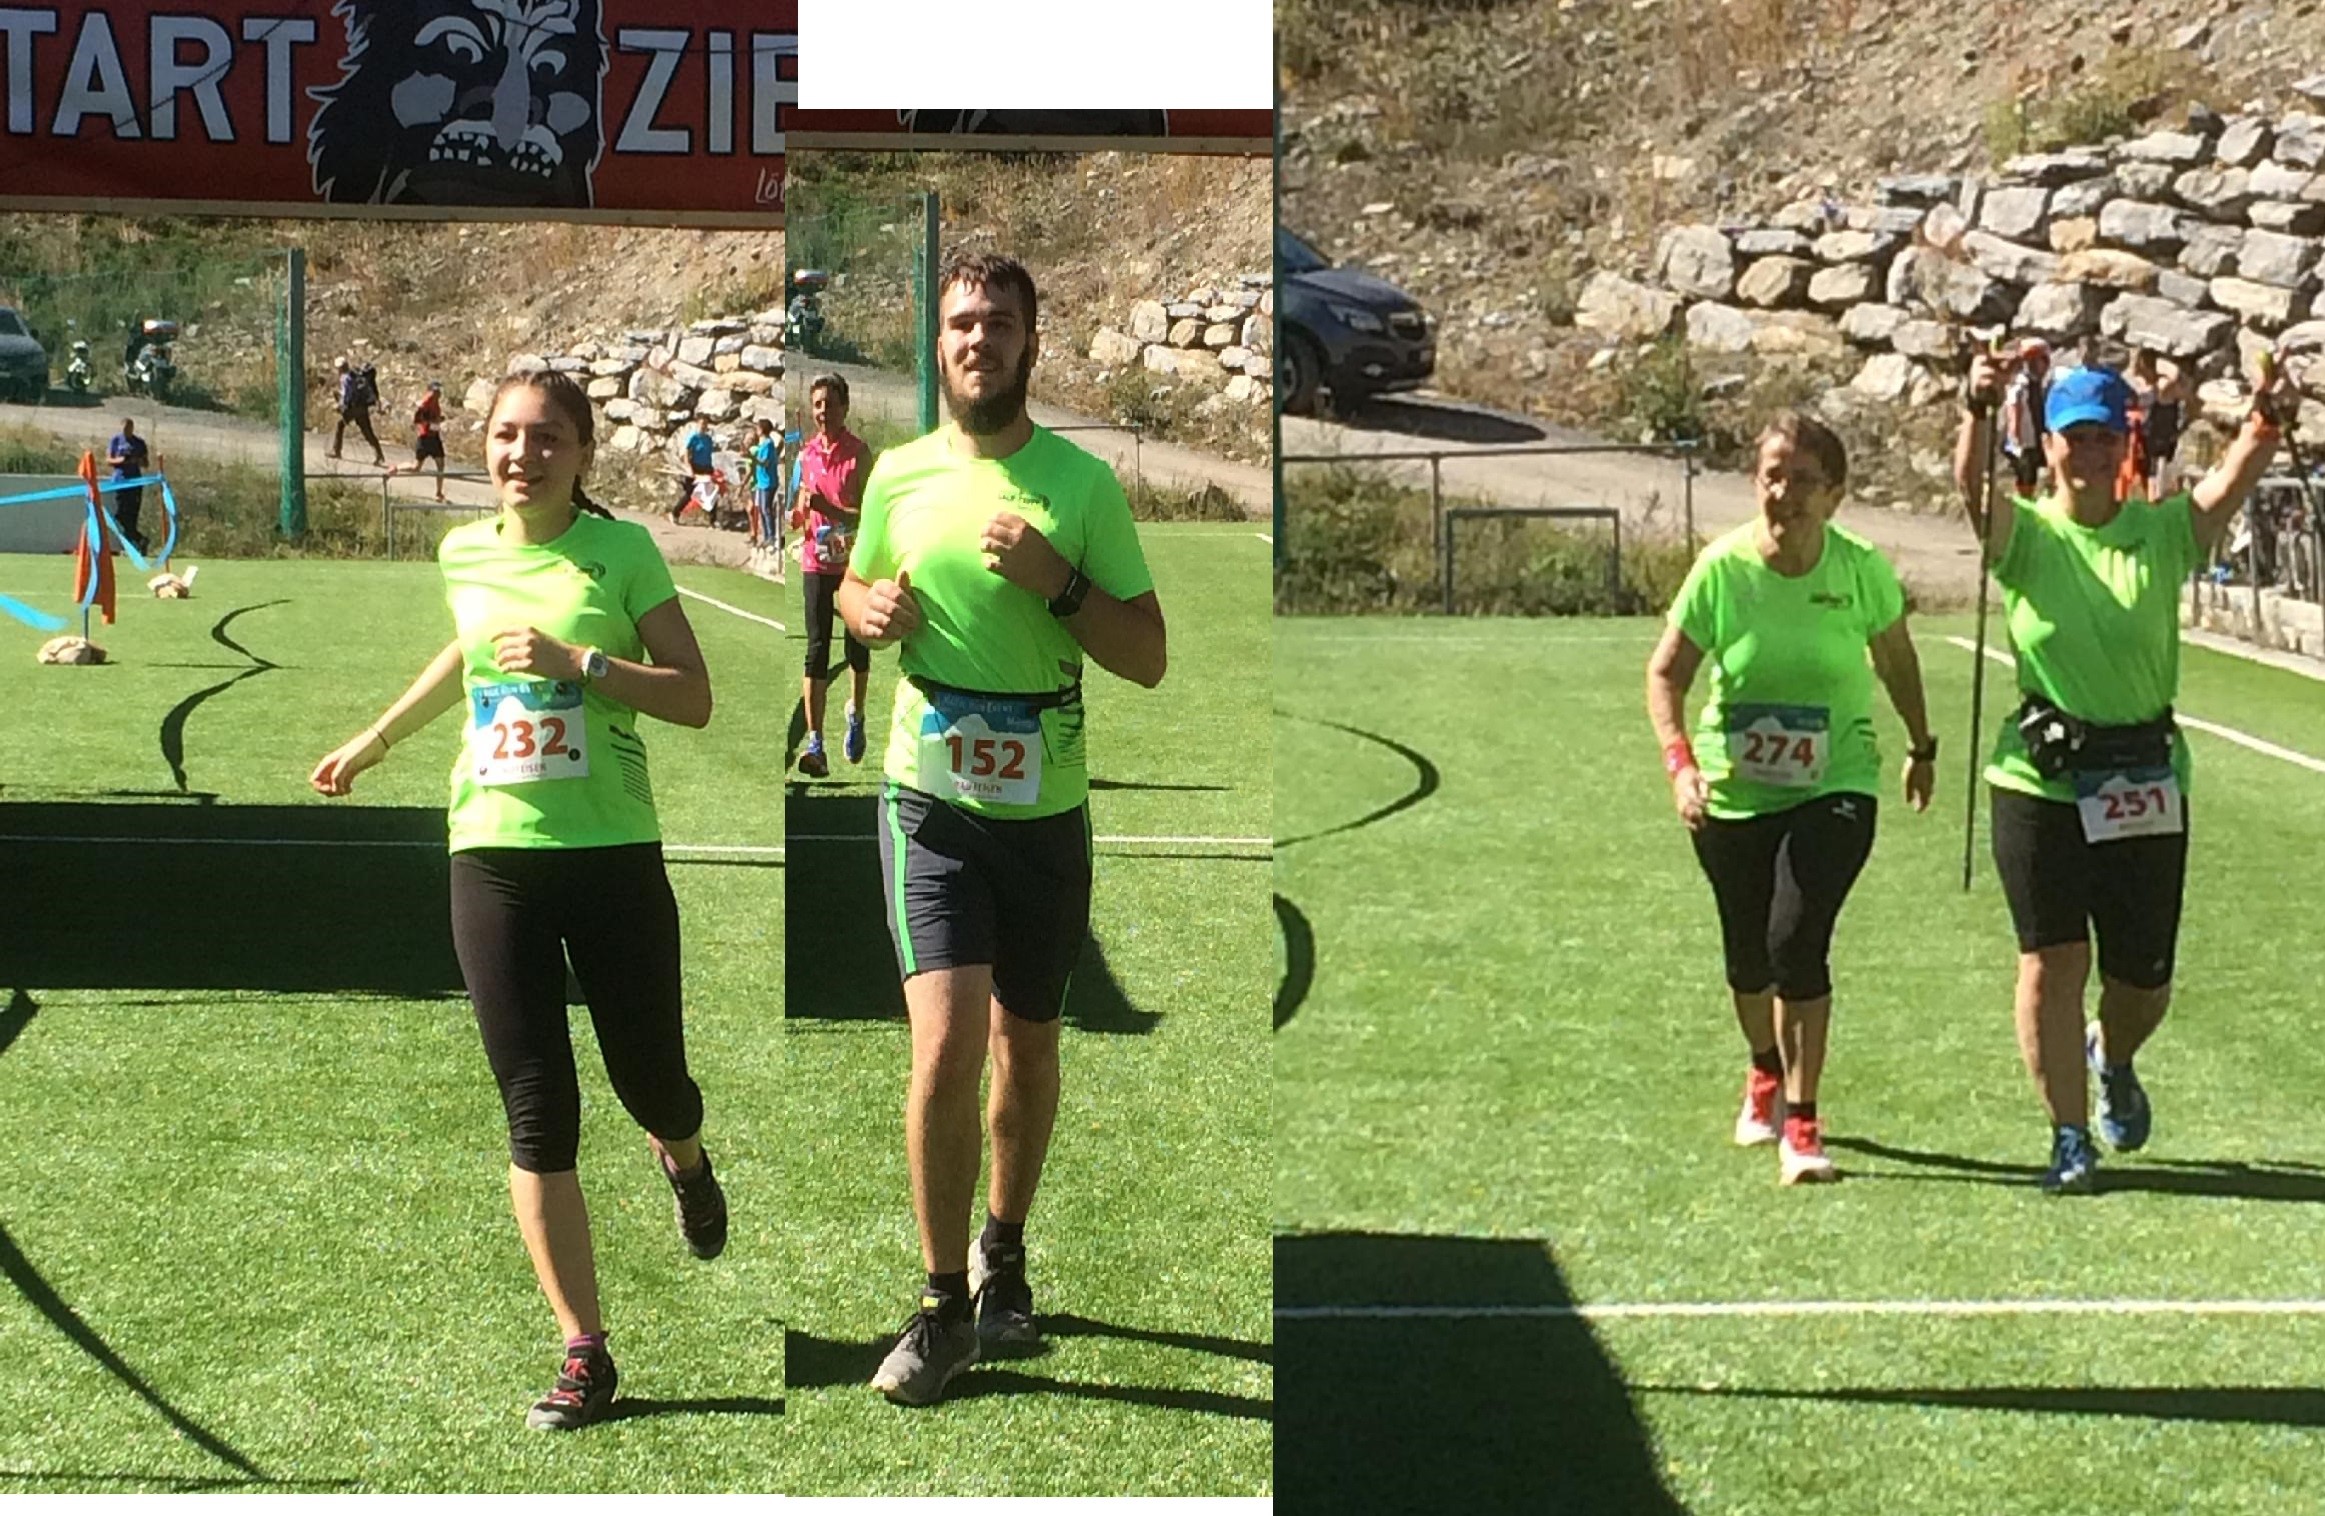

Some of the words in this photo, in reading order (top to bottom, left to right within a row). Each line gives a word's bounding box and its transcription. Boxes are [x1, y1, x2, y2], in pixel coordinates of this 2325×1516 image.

[493, 716, 568, 760] 232
[945, 735, 1026, 780] 152
[1742, 730, 1815, 768] 274
[2097, 787, 2167, 822] 251
